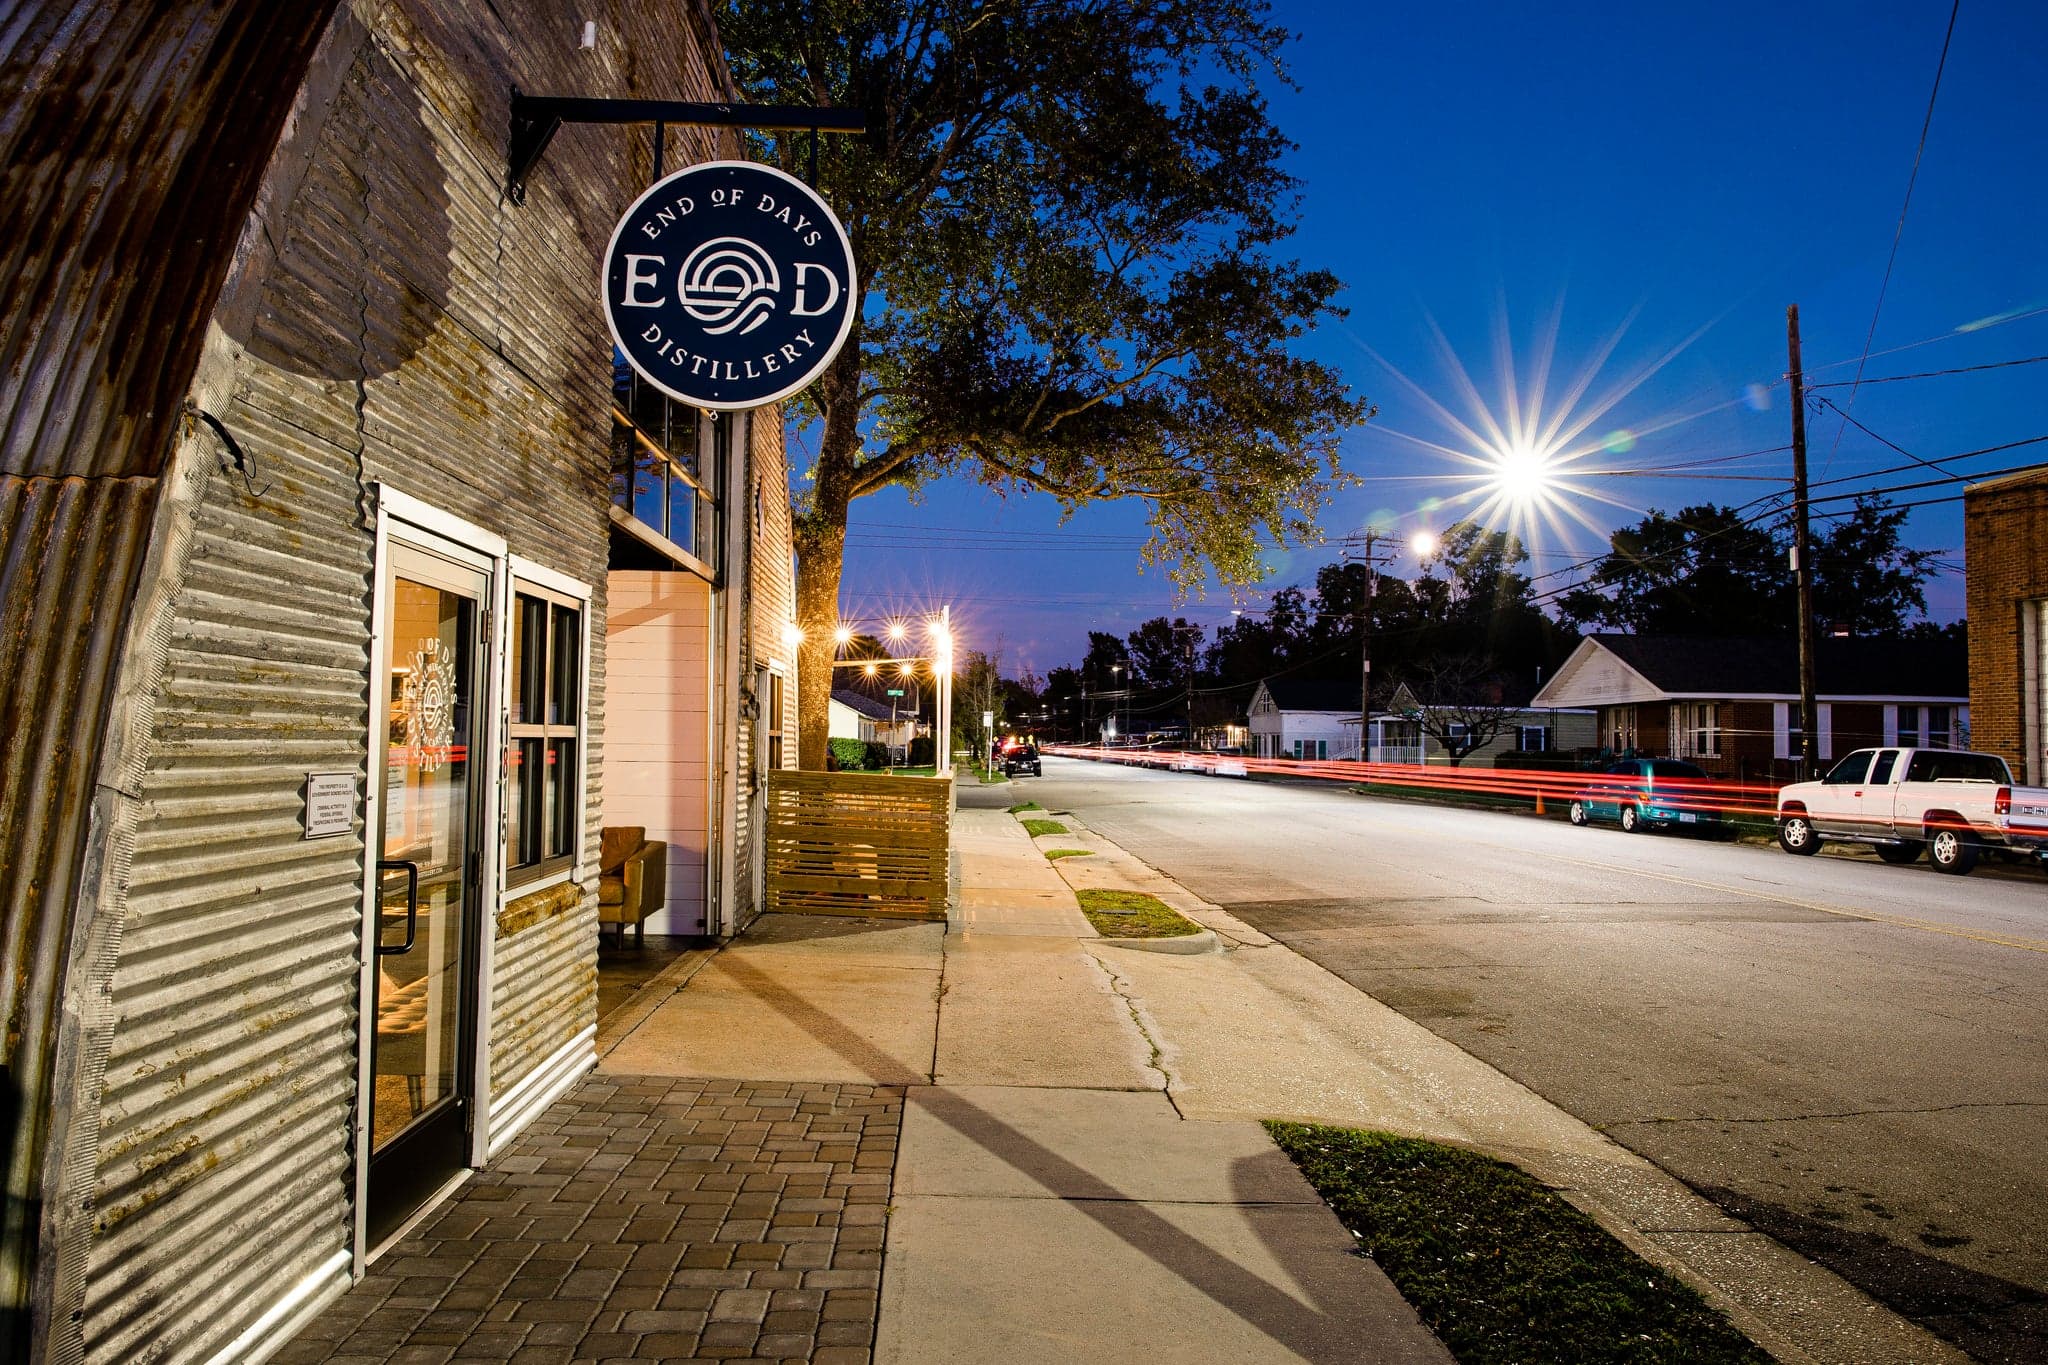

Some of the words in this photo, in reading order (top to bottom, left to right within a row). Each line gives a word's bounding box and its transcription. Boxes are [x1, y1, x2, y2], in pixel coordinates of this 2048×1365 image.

[641, 196, 695, 240] END
[711, 188, 744, 208] OF
[756, 194, 822, 248] DAYS
[641, 323, 815, 381] DISTILLERY
[442, 646, 458, 704] DAYS
[408, 718, 456, 772] DISTILLERY
[501, 713, 509, 845] 1815
[2022, 806, 2048, 817] CH
